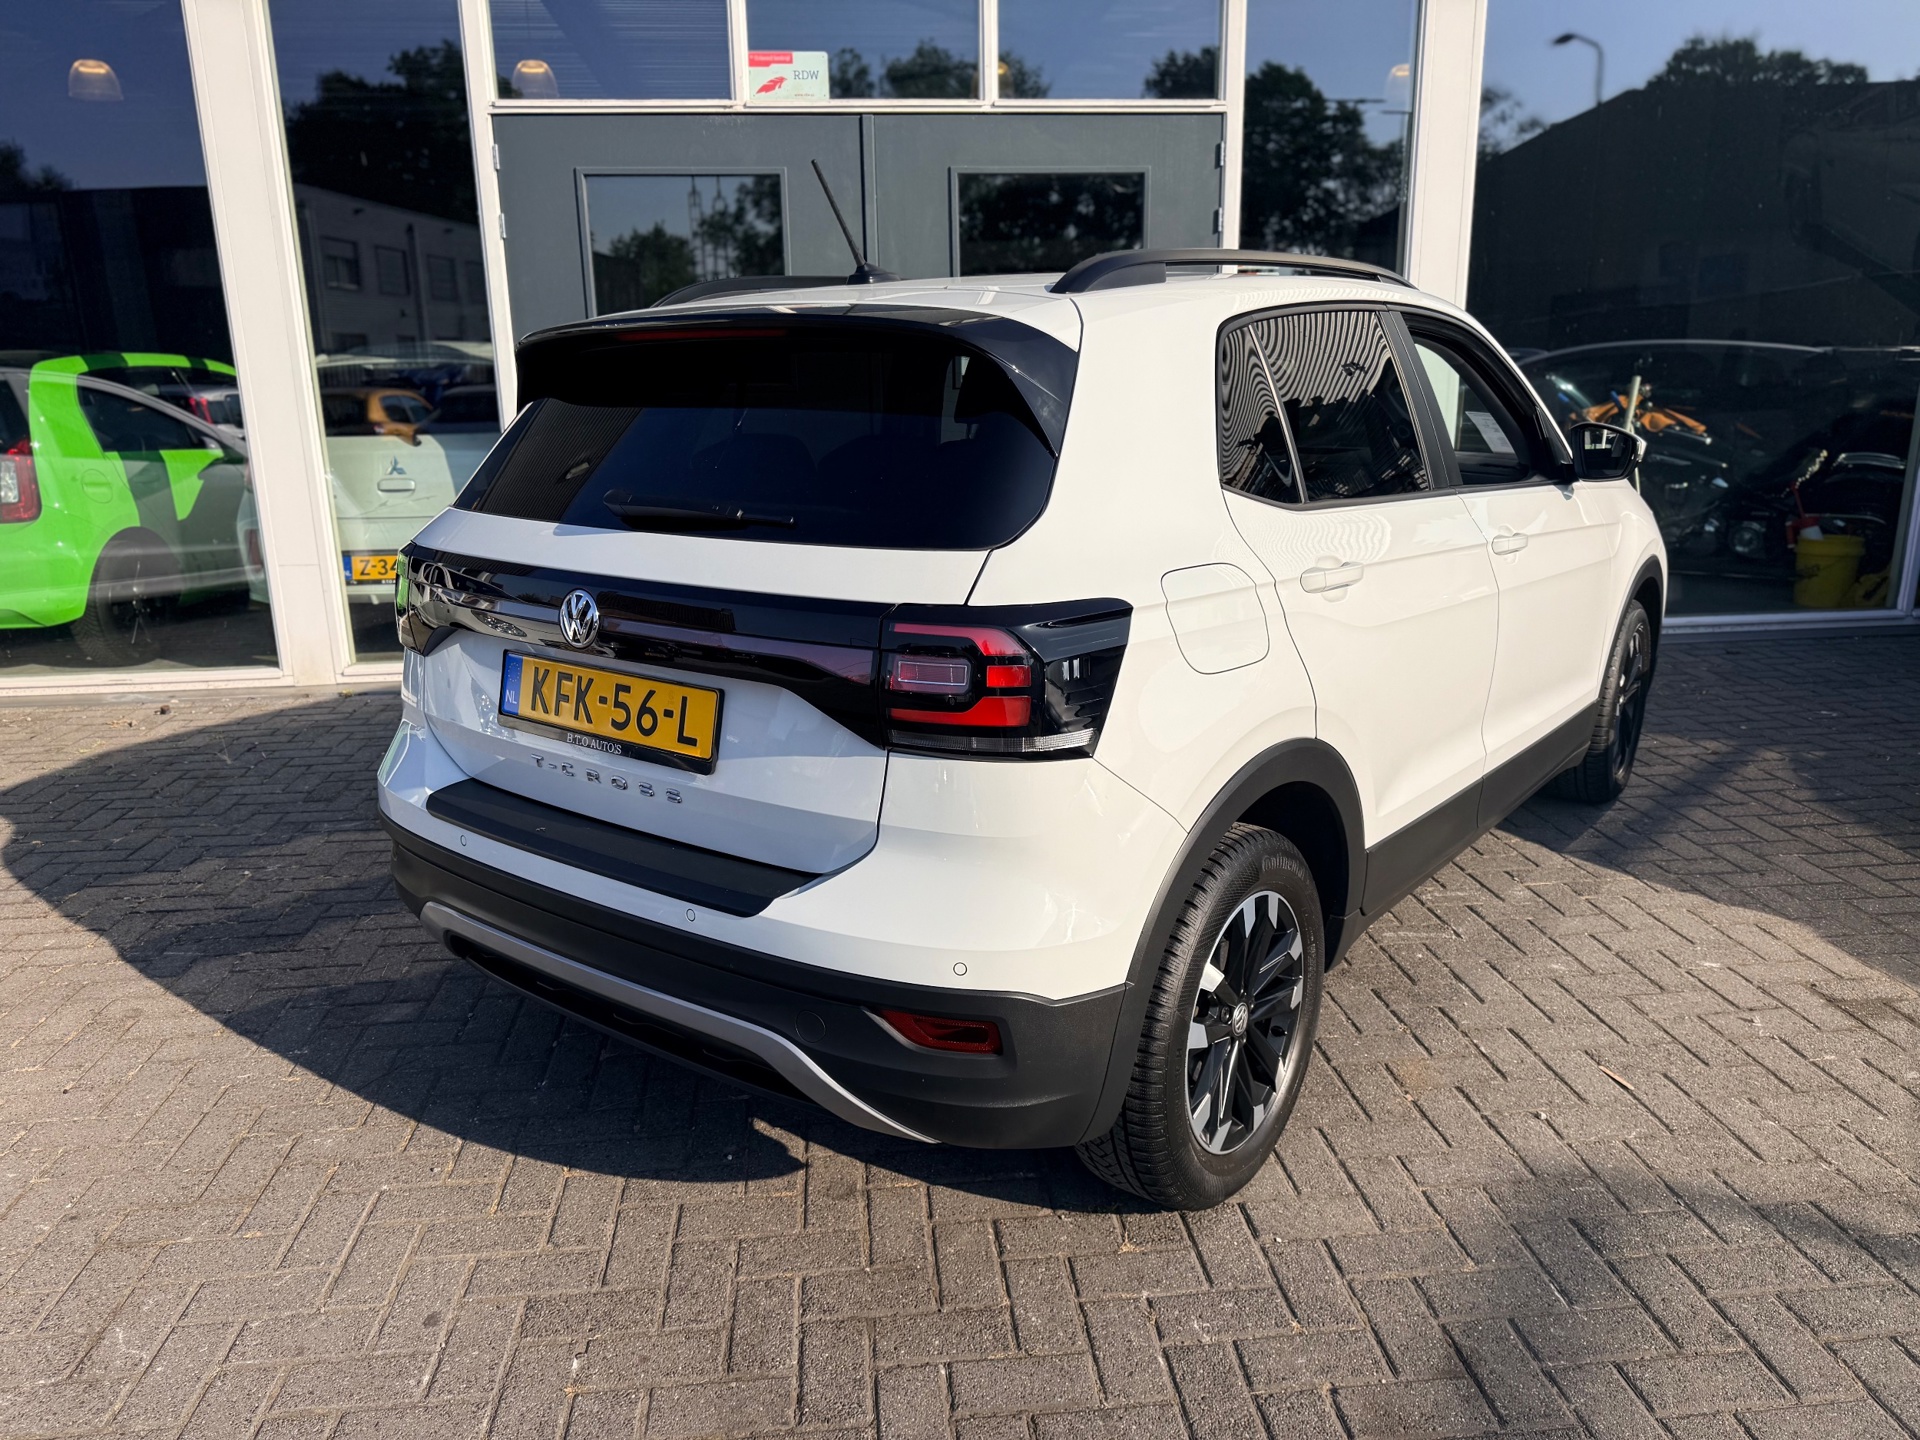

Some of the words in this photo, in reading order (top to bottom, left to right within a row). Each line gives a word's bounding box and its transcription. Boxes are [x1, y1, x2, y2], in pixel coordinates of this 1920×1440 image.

[793, 70, 819, 80] RDW
[505, 689, 517, 705] NL
[531, 666, 698, 747] KFK-56-L
[566, 732, 589, 747] B.T.O
[530, 753, 683, 804] T-CROSS
